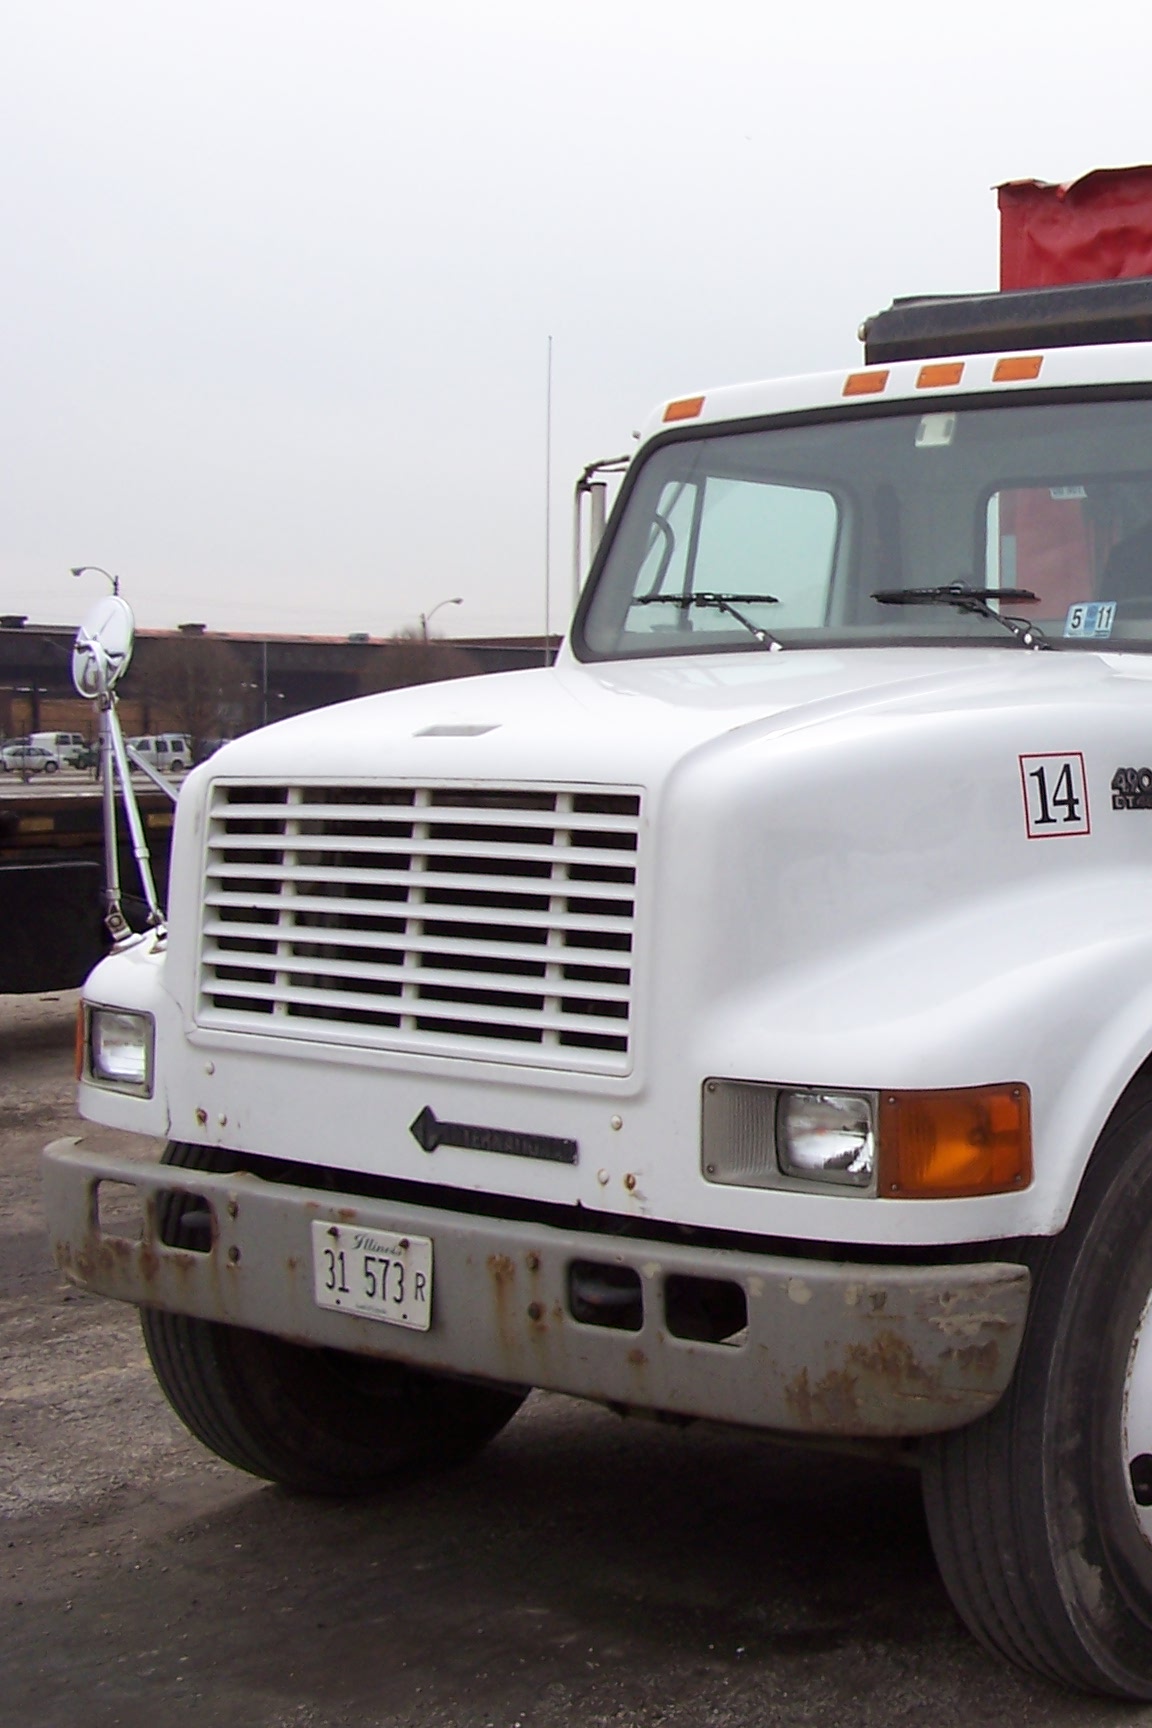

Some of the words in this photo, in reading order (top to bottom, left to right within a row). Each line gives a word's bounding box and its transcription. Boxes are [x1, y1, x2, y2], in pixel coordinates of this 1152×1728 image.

[1071, 608, 1083, 629] 5
[1098, 606, 1112, 629] 11
[1029, 763, 1082, 825] 14
[352, 1233, 402, 1256] Illinois
[324, 1248, 350, 1293] 31
[364, 1255, 405, 1304] 573
[414, 1272, 426, 1301] R
